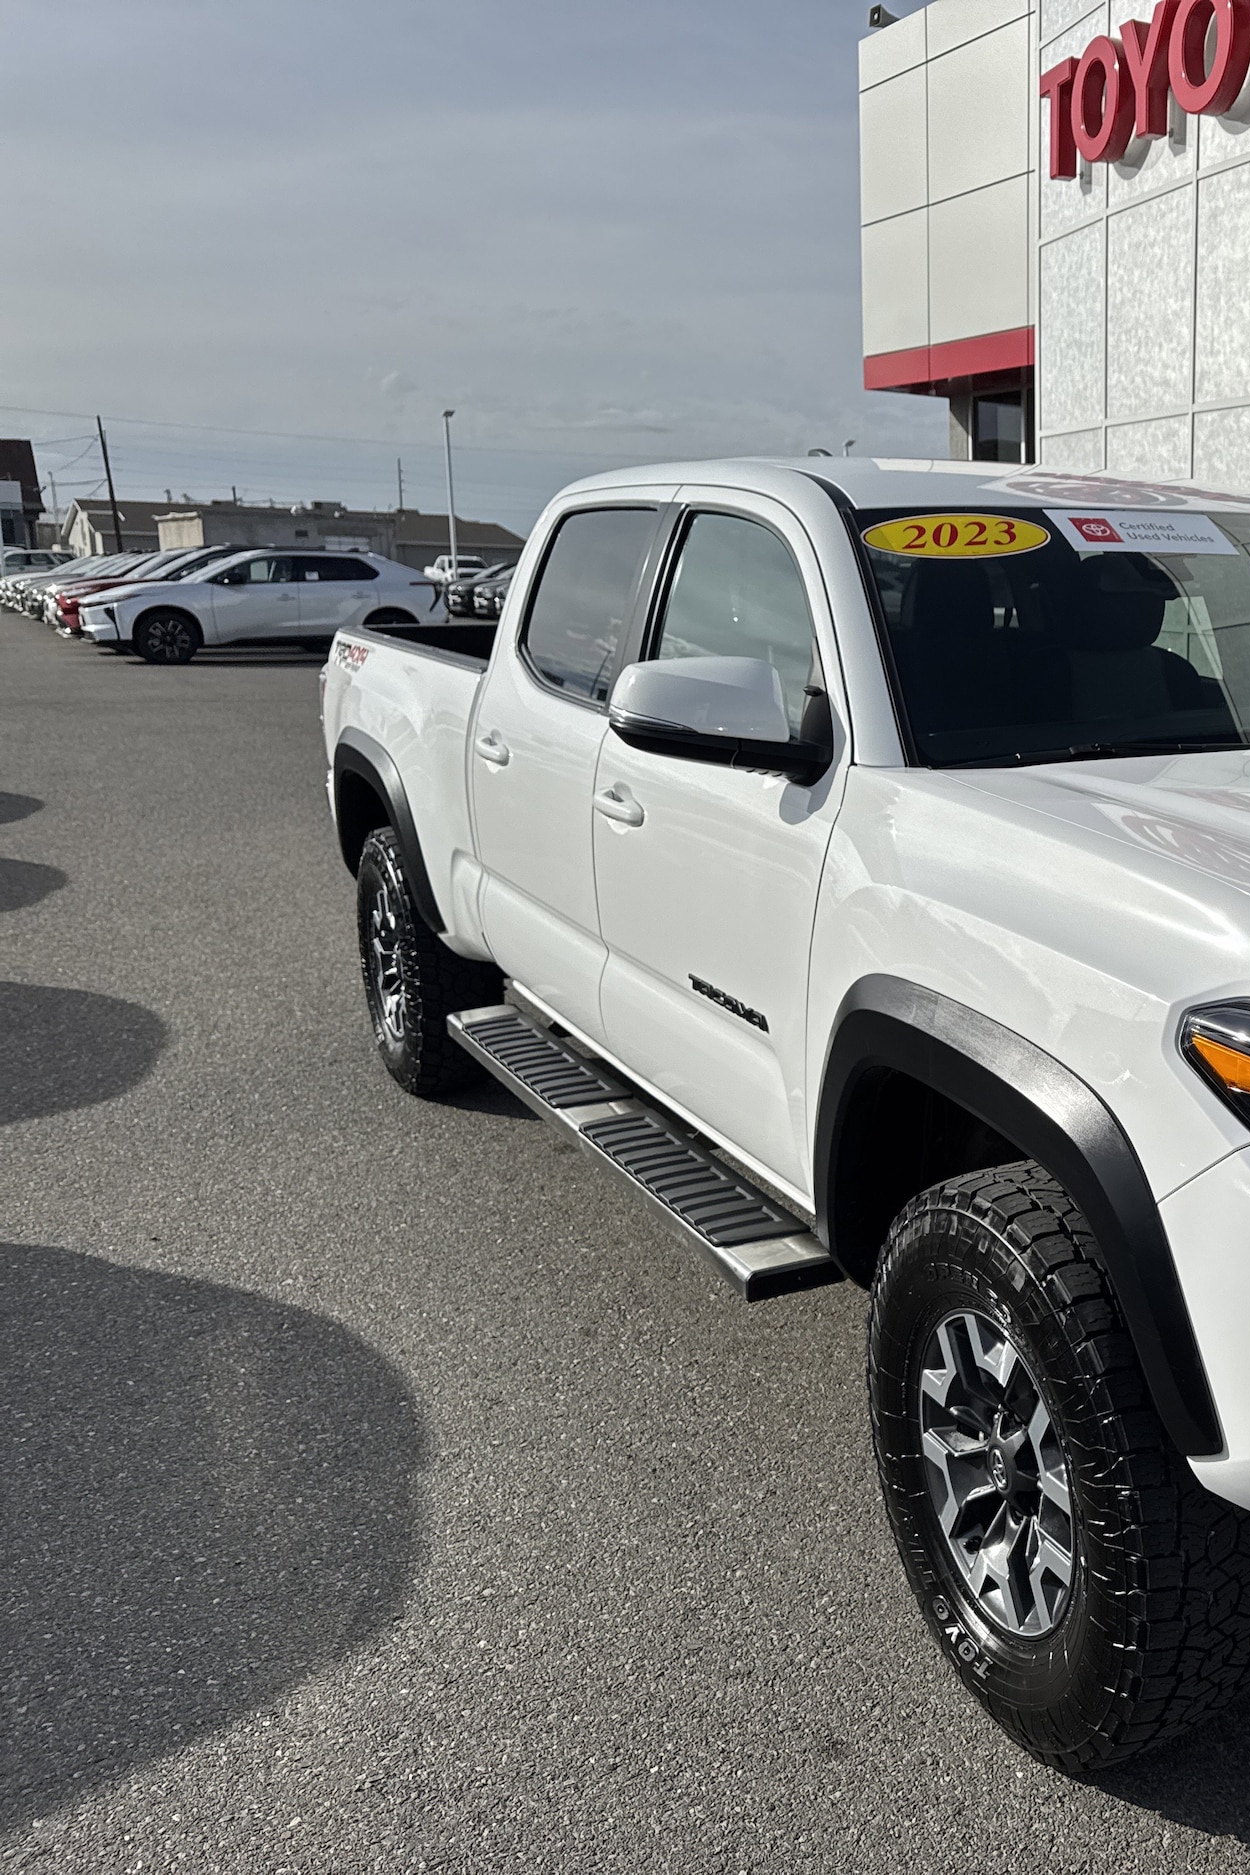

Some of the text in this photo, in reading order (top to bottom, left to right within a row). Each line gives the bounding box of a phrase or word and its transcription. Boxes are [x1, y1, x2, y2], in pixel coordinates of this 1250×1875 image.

[902, 521, 1017, 550] 2023
[1119, 522, 1175, 532] Certified
[1126, 532, 1214, 543] Used Vehicles
[688, 973, 769, 1034] TACOMA
[932, 1595, 993, 1679] TOYO
